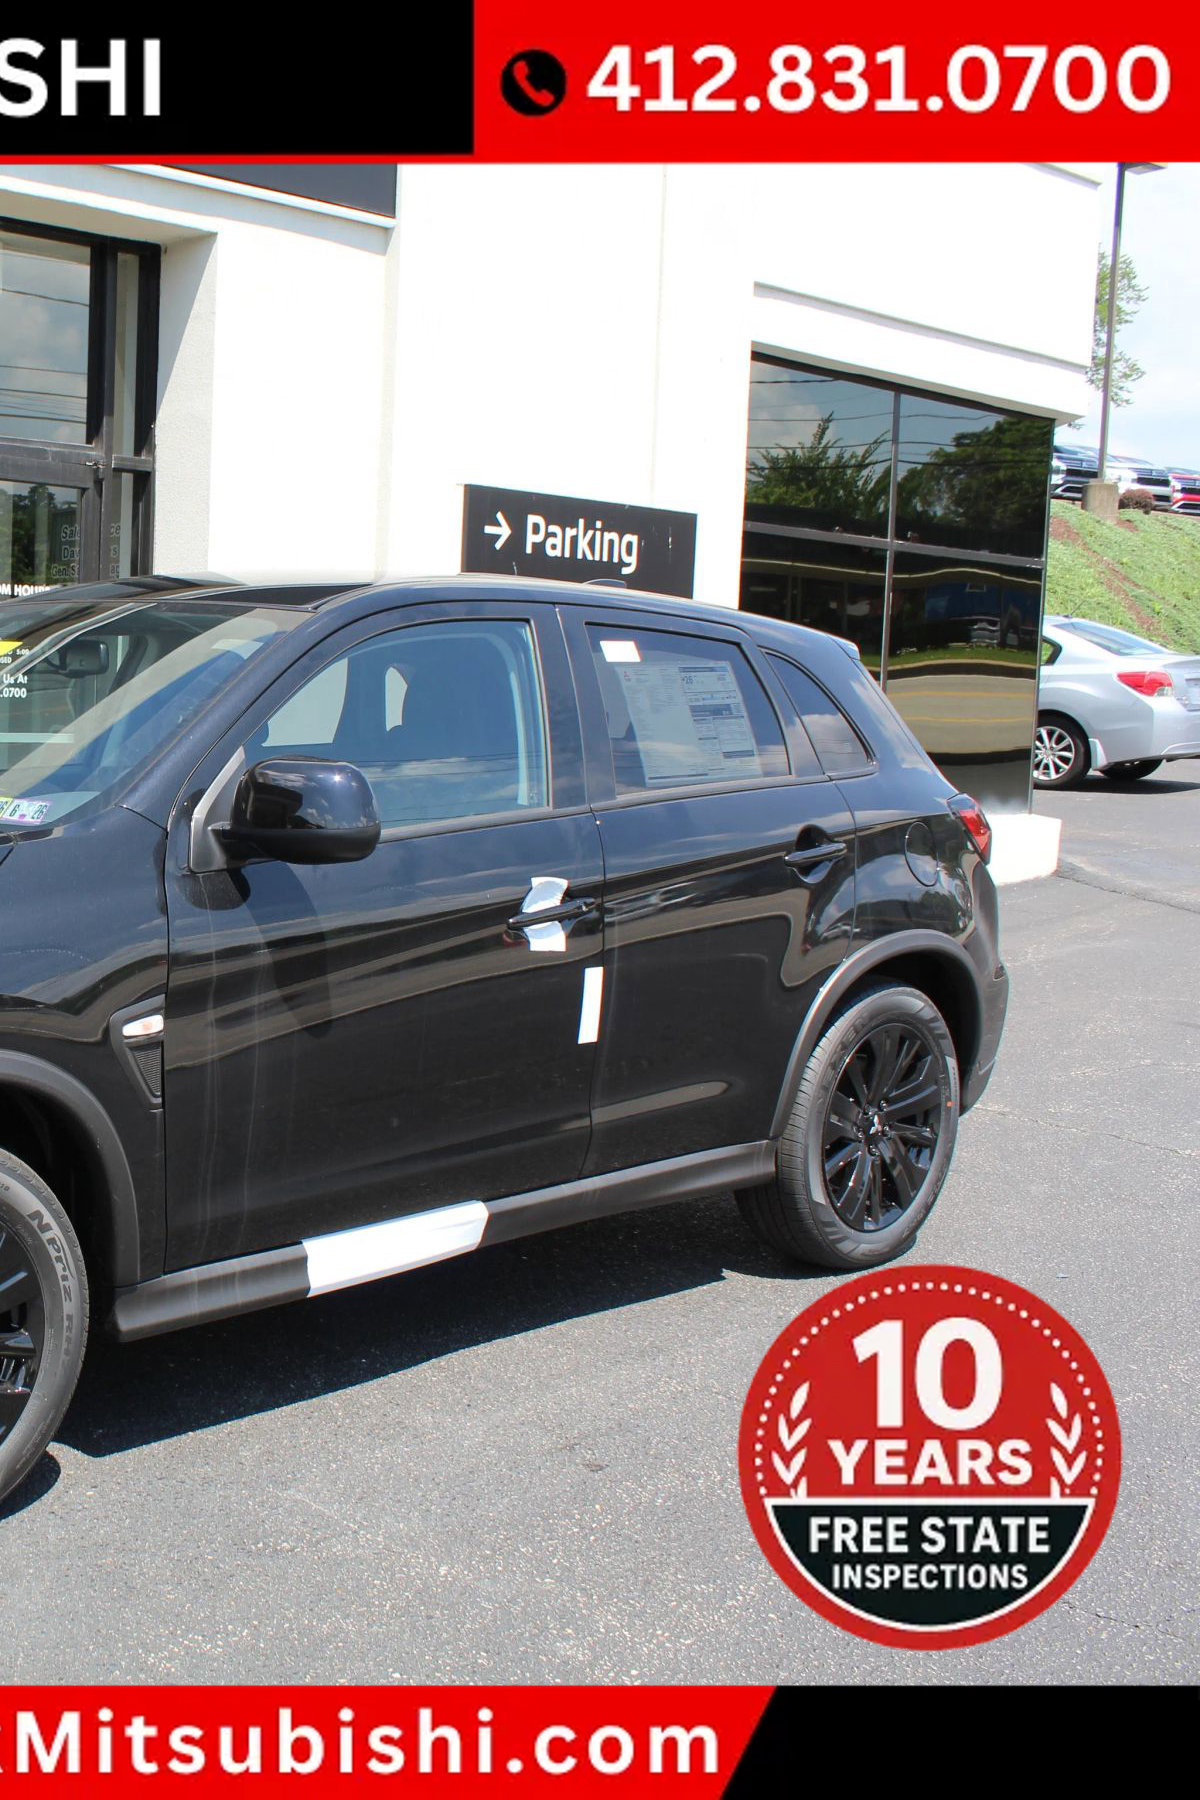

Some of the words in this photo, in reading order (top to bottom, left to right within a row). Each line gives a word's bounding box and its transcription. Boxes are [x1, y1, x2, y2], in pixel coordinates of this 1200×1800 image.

[525, 514, 639, 575] Parking
[3, 674, 15, 684] Us
[17, 674, 28, 684] At
